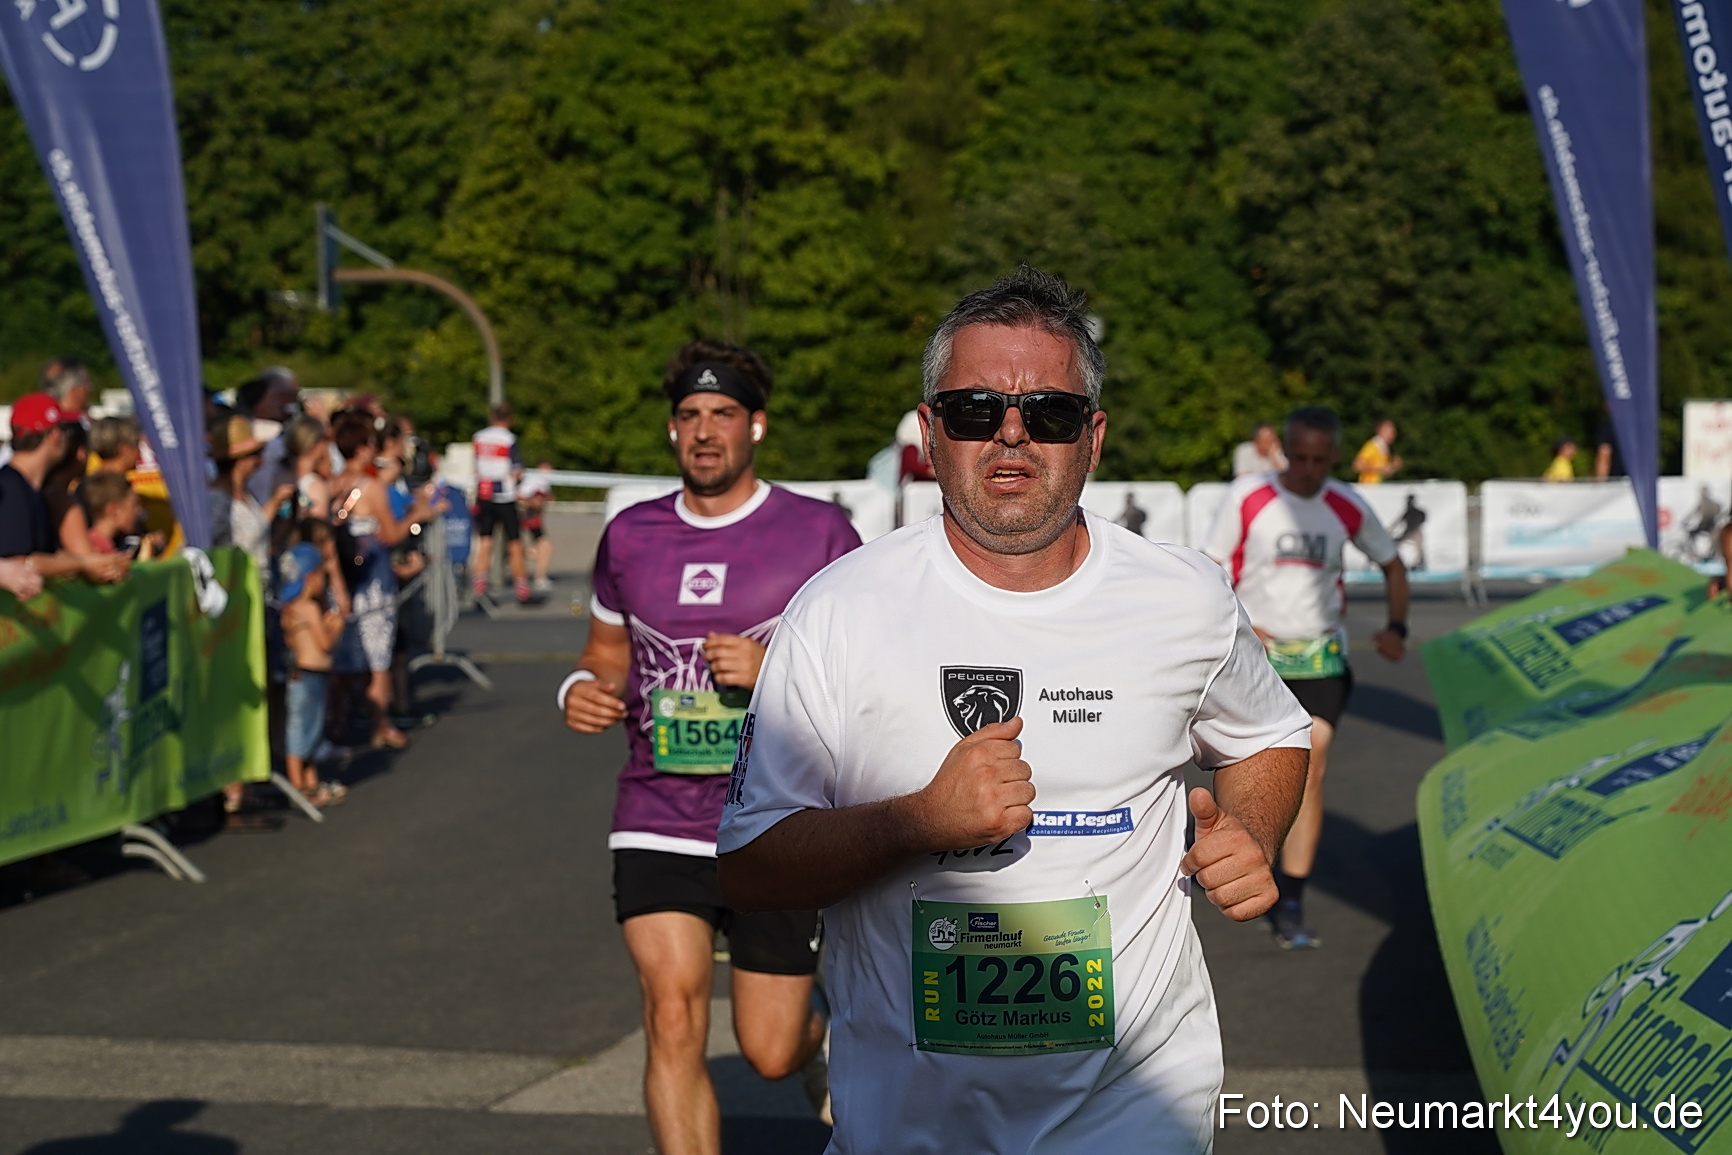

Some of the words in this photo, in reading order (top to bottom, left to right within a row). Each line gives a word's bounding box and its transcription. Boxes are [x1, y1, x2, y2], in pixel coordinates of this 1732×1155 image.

[947, 672, 1015, 682] PEUGEOT
[1038, 687, 1113, 702] Autohaus
[1052, 709, 1102, 723] Müller
[669, 719, 740, 746] 1564
[1033, 813, 1073, 826] Karl
[1075, 812, 1123, 827] Seger
[1092, 825, 1130, 835] Recyclinghof
[974, 918, 997, 926] Fischer
[960, 929, 1023, 943] Firmenlauf
[984, 941, 1022, 949] neumarkt
[945, 953, 1081, 1005] 1226
[923, 971, 941, 1022] RUN
[1086, 958, 1105, 1028] 2022
[955, 1009, 997, 1026] Götz
[1003, 1009, 1072, 1026] Markus
[1007, 1032, 1028, 1040] Müller
[1029, 1031, 1050, 1039] GmbH
